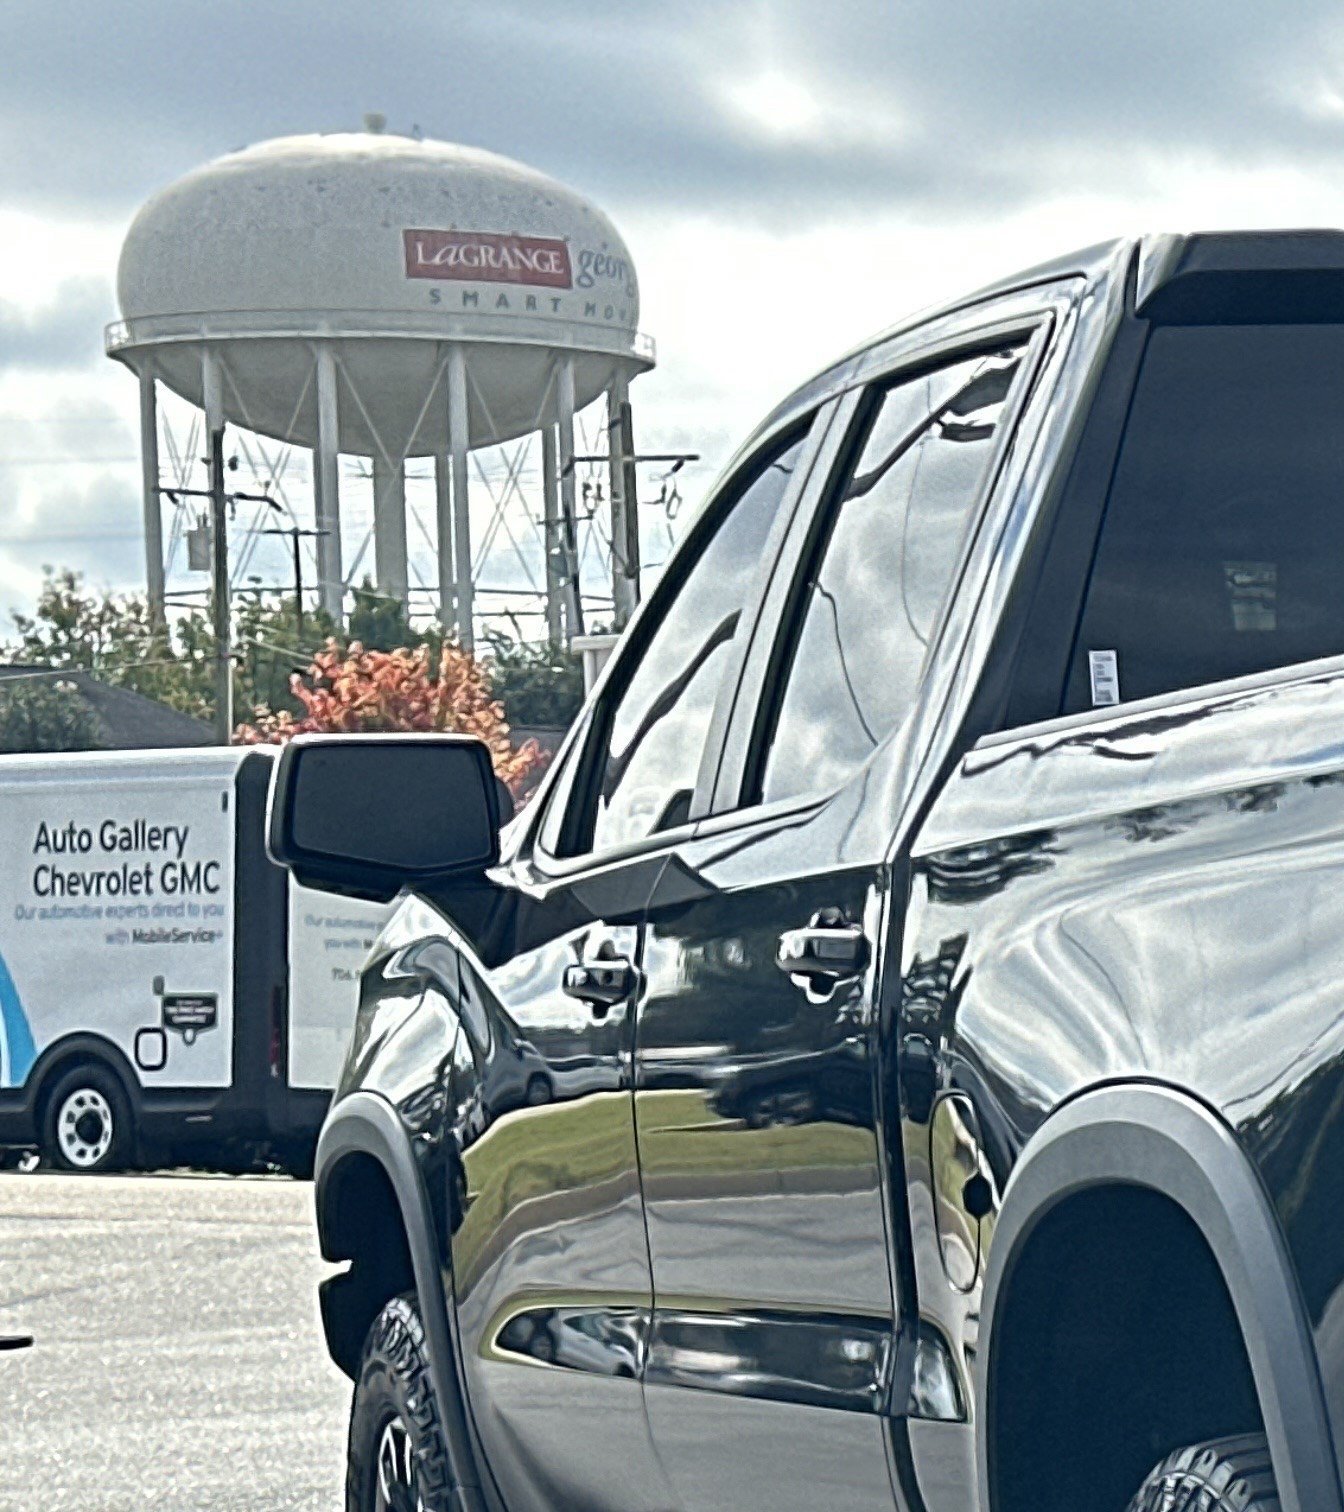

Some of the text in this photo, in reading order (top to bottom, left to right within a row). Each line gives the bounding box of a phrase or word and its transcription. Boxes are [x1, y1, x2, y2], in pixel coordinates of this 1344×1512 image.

[429, 287, 562, 312] SMART
[33, 818, 189, 860] Auto Gallery
[33, 860, 221, 897] Chevrolet GMC
